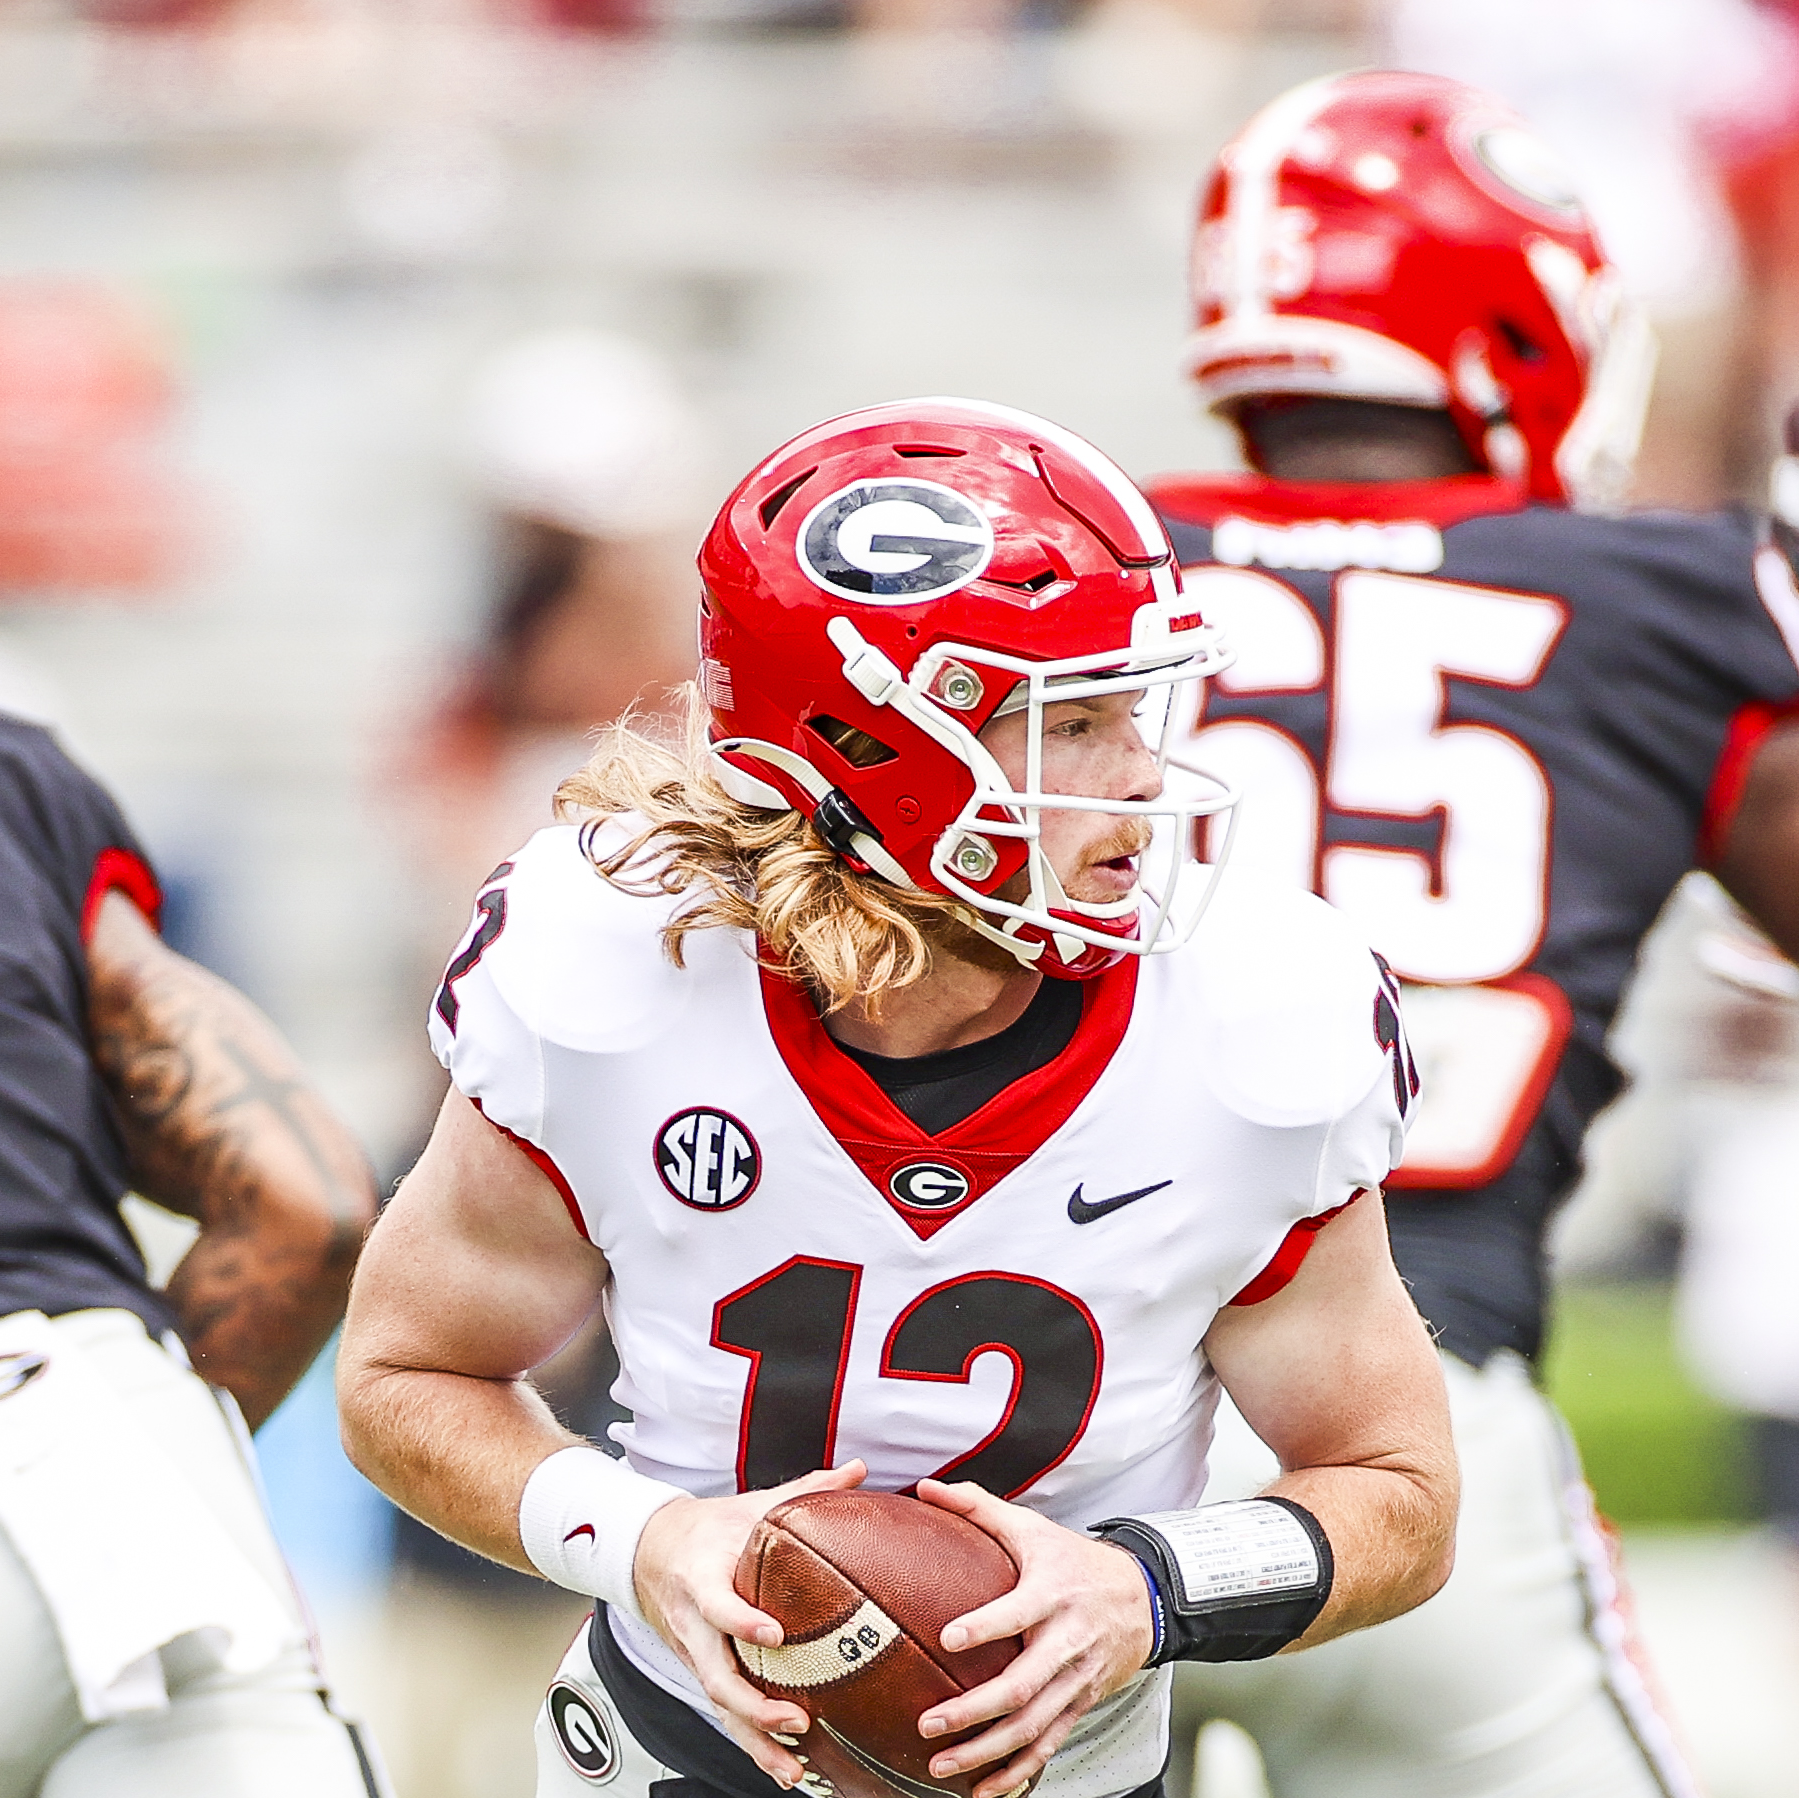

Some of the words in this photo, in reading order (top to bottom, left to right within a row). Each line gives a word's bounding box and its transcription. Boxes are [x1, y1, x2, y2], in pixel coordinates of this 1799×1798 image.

[806, 487, 985, 594] G
[1147, 563, 1571, 984] 65
[663, 1114, 752, 1204] SEC
[894, 1167, 967, 1205] G
[710, 1253, 1104, 1499] 12
[553, 1689, 611, 1769] G
